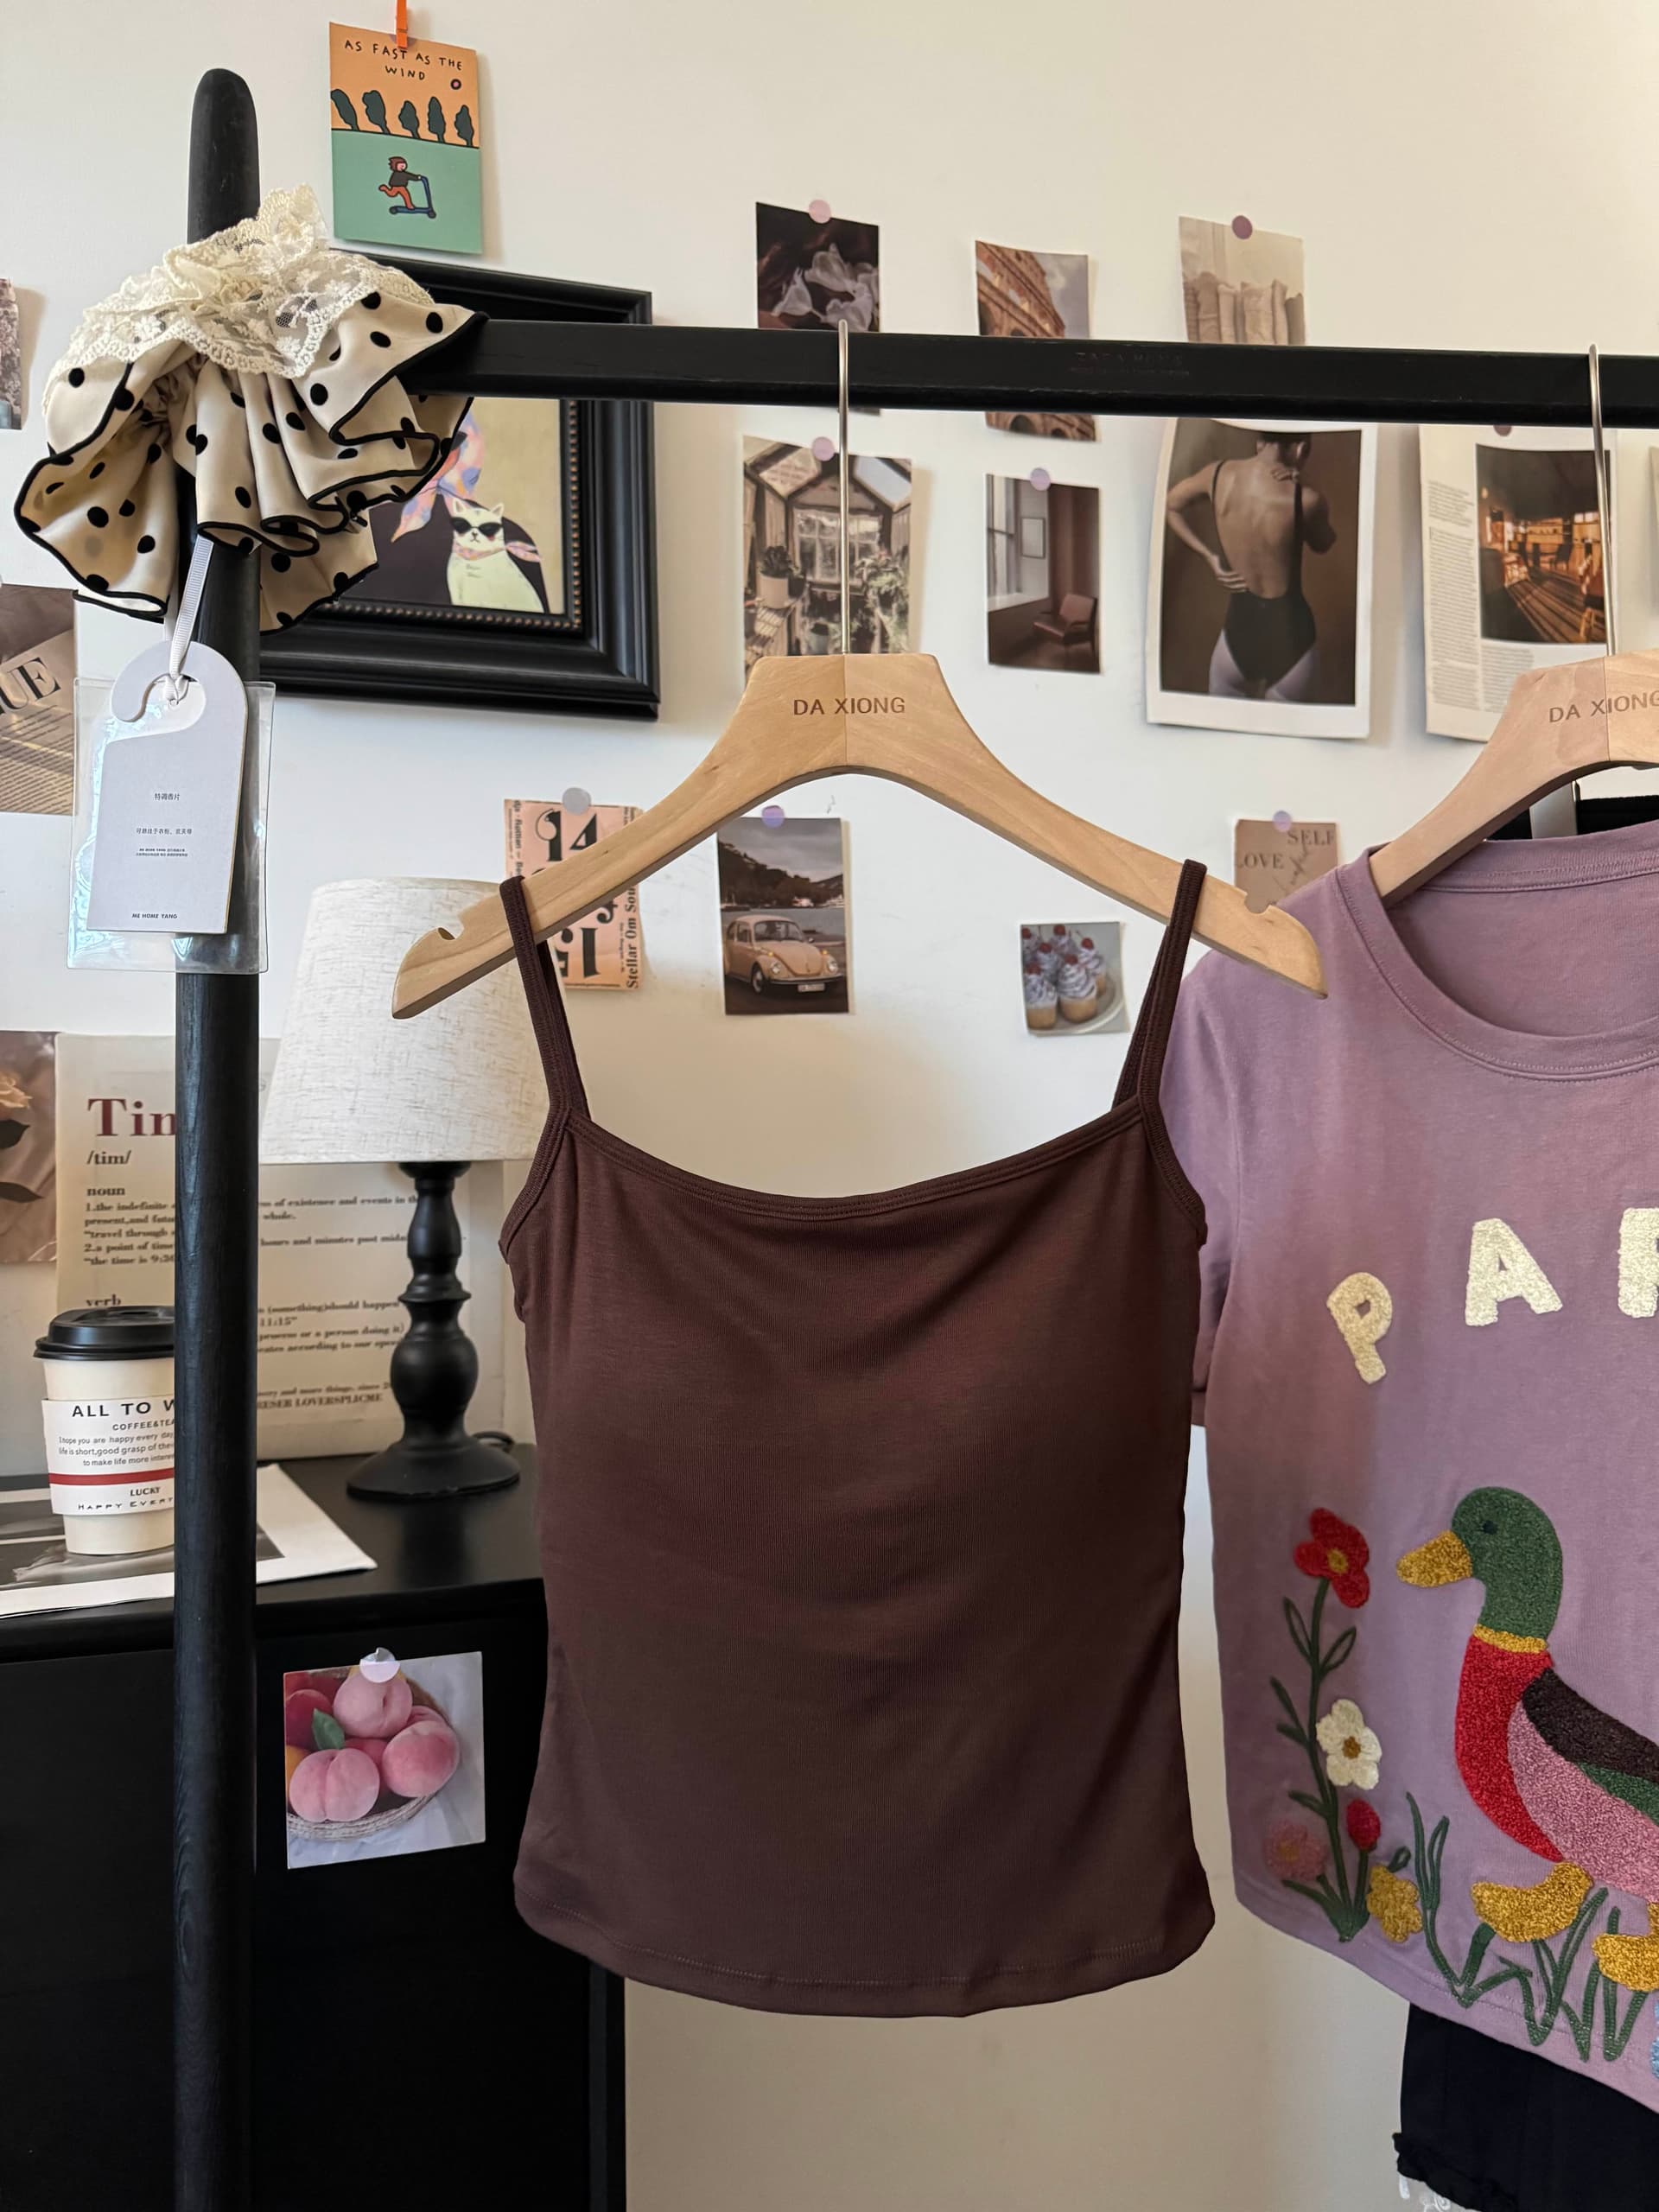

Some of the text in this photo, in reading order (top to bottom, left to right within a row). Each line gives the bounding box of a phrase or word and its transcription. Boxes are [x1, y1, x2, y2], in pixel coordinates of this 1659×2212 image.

[345, 40, 462, 70] AS FAST AS THE
[385, 66, 425, 80] WIND
[0, 657, 61, 715] UE
[793, 696, 906, 715] DA XIONG
[1549, 704, 1581, 723] DA
[625, 885, 637, 913] Sou
[626, 943, 639, 988] Stellar
[86, 1150, 131, 1166] /tim/
[86, 1186, 125, 1197] noun
[117, 1201, 168, 1211] indefinite
[288, 1198, 334, 1206] existence
[338, 1196, 358, 1205] and
[293, 1236, 312, 1245] and
[85, 1294, 122, 1306] verb
[72, 1404, 110, 1418] ALL
[121, 1402, 151, 1415] TO
[109, 1435, 135, 1445] happy
[121, 1446, 146, 1455] grasp
[148, 1443, 156, 1452] of
[114, 1457, 126, 1465] life
[130, 1486, 161, 1497] LUCKY
